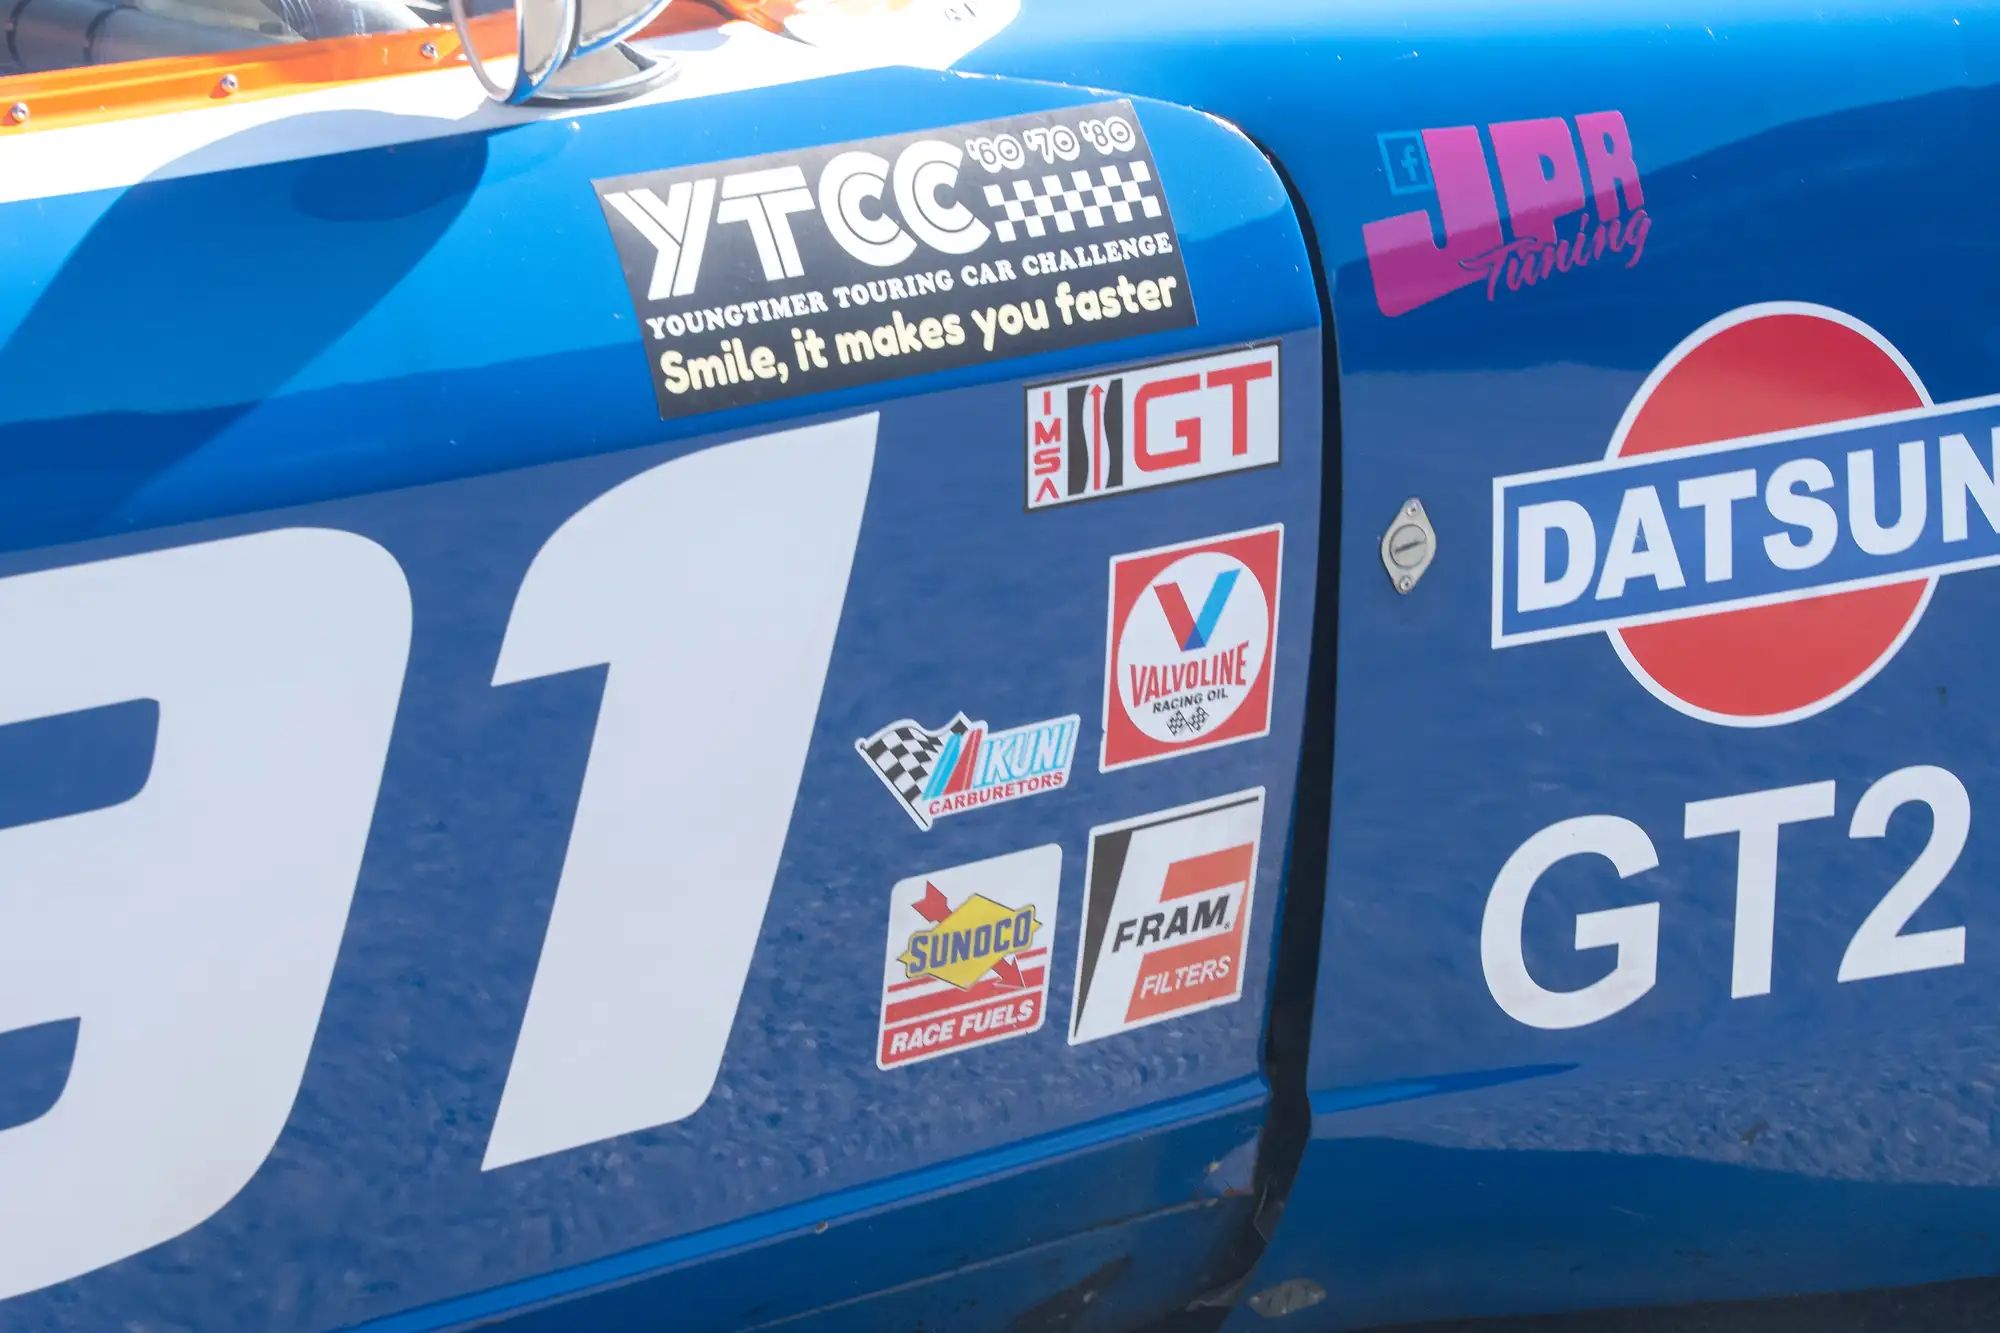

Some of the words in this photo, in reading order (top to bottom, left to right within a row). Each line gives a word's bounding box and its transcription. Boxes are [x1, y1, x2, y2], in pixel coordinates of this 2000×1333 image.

[603, 140, 992, 301] YTCC
[1362, 110, 1645, 317] JPR
[1457, 208, 1652, 302] Tuning
[646, 292, 829, 340] YOUNGTIMER
[832, 268, 955, 311] TOURING
[961, 258, 1018, 287] CAR
[1021, 231, 1174, 276] CHALLENGE
[659, 336, 789, 394] Smile,
[791, 328, 829, 371] it
[835, 310, 966, 365] makes
[968, 299, 1050, 352] you
[1053, 272, 1177, 325] faster
[1033, 391, 1062, 503] IMSA
[1133, 360, 1273, 473] GT
[1517, 426, 2000, 613] DATSUN
[1129, 641, 1250, 709] VALVOLINE
[1152, 691, 1203, 714] RACING
[1207, 687, 1229, 703] OIL
[928, 771, 1064, 816] CARBURETORS
[908, 909, 1034, 974] SUNOCO
[1480, 765, 1972, 1030] GT2
[889, 1015, 954, 1056] RACE
[959, 999, 1035, 1036] FUELS
[1139, 955, 1231, 1000] FILTERS
